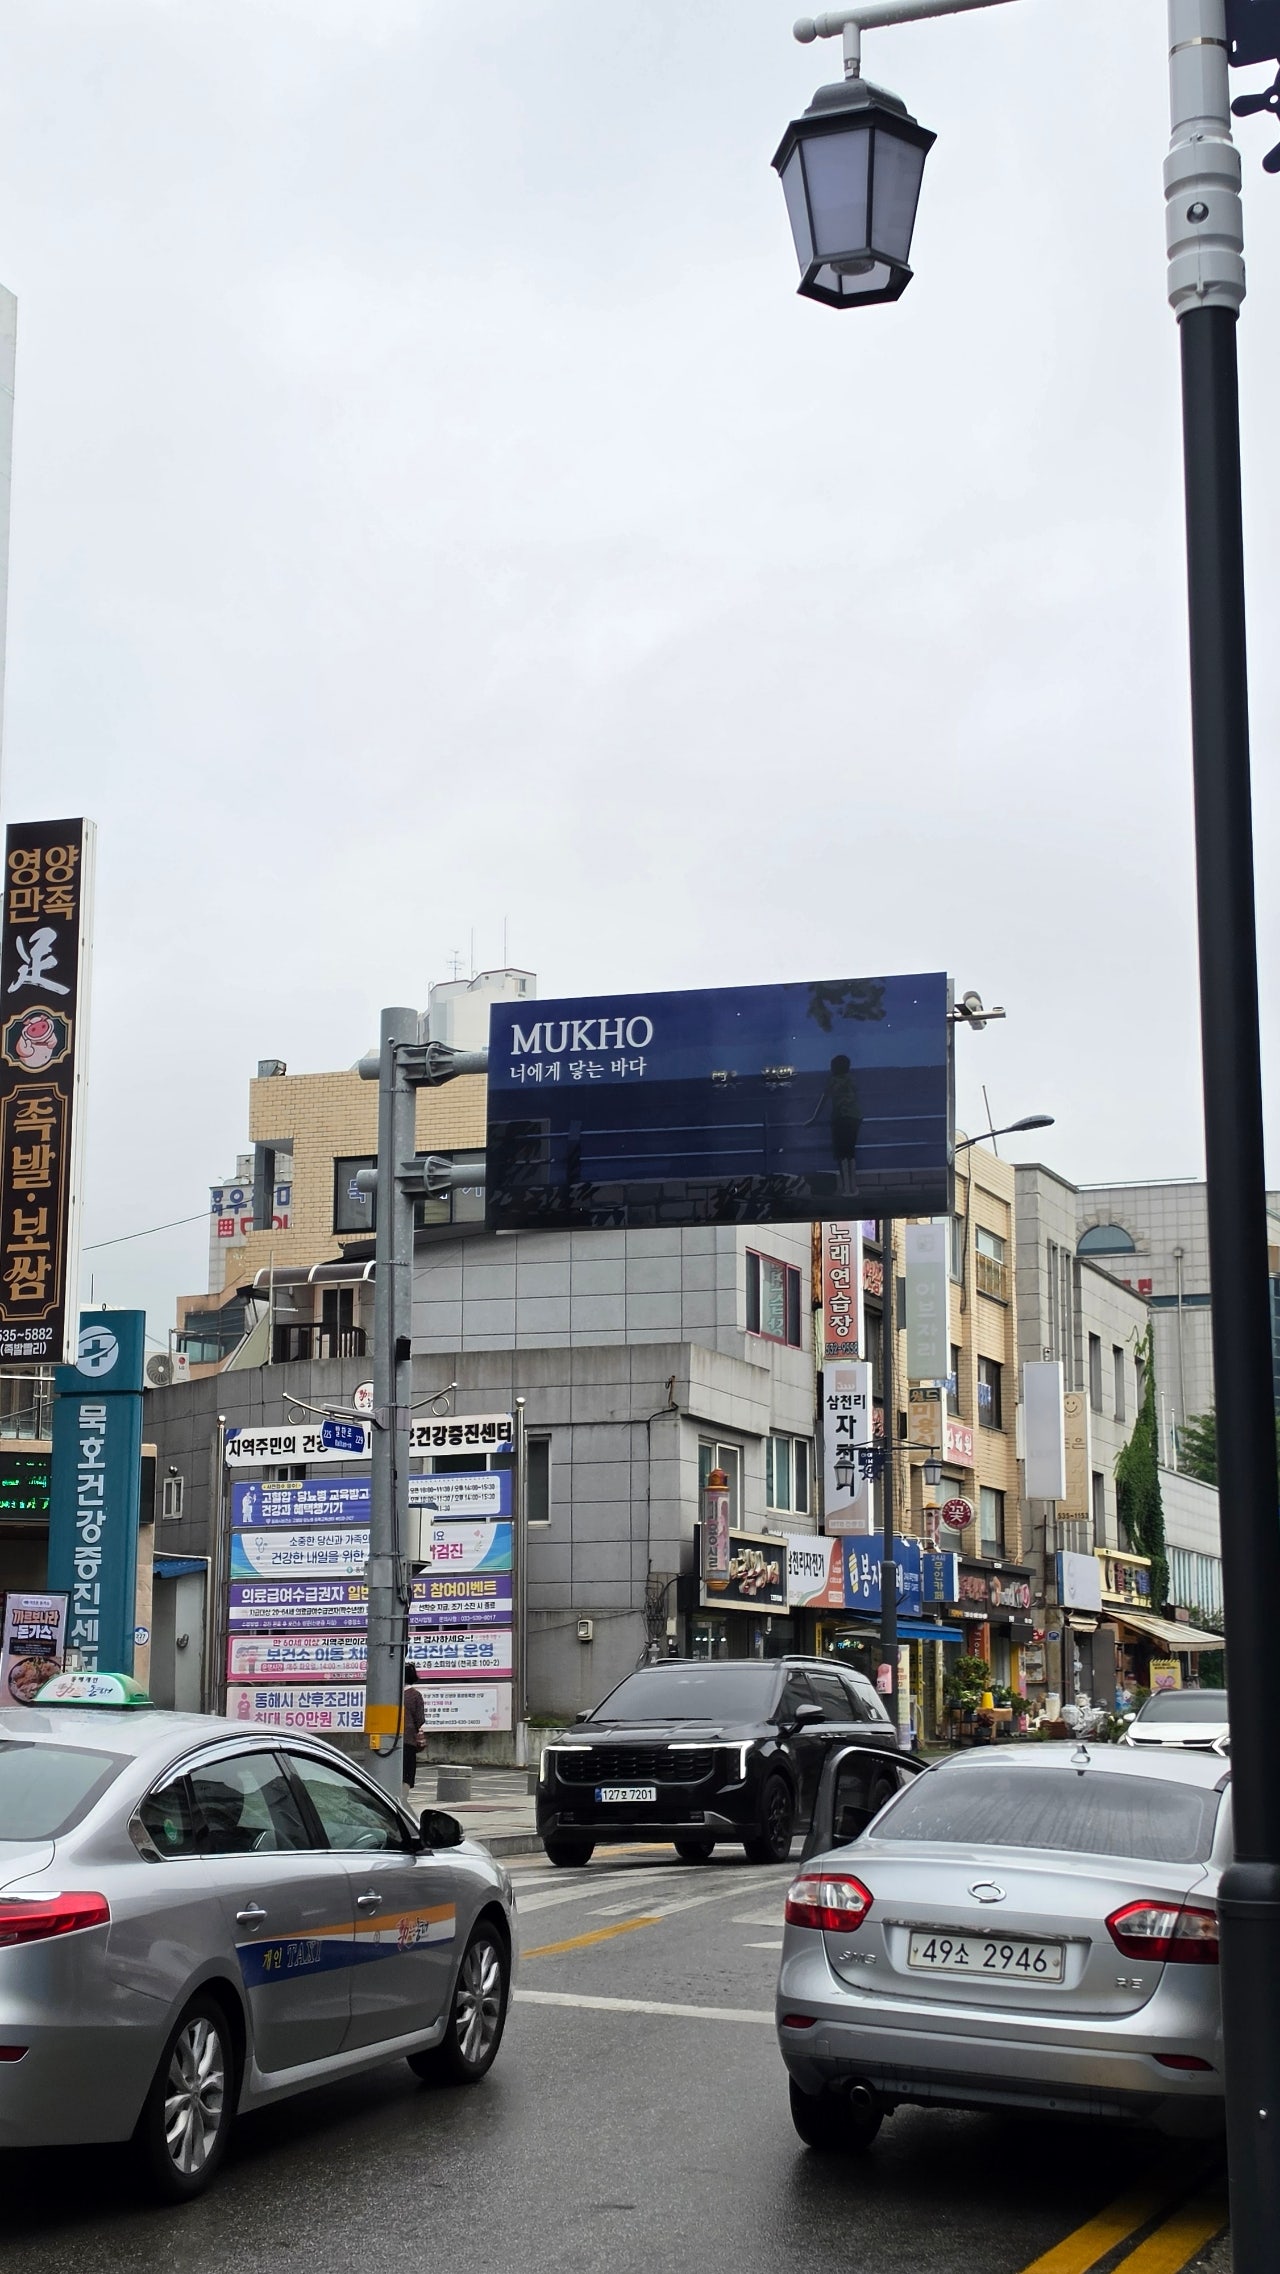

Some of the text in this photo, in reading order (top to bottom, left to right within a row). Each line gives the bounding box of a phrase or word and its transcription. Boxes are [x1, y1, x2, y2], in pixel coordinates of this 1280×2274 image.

[8, 844, 79, 885] 영양
[9, 885, 75, 923] 만족
[8, 927, 70, 996] 足
[511, 1015, 654, 1055] MUKHO
[510, 1056, 647, 1082] 너에게 닿는 바다
[828, 1223, 853, 1337] 노래연습장
[826, 1394, 866, 1410] 삼천리
[911, 1389, 939, 1401] 월드
[228, 1435, 296, 1457] 지역주민의
[329, 1488, 369, 1501] 교육받고
[262, 1502, 343, 1517] 건강과 혜택챙기기
[948, 1505, 965, 1522] 꽃
[289, 1536, 315, 1547] 소중한
[317, 1535, 342, 1546] 당신과
[272, 1549, 364, 1565] 건강한 내일을 위한
[934, 1562, 945, 1600] 무인카페
[241, 1586, 344, 1604] 의료급여수급권자
[430, 1580, 497, 1598] 참여이벤트
[464, 1602, 475, 1610] 소진
[13, 1609, 58, 1626] 까르보나라
[18, 1625, 52, 1639] 돈가스
[267, 1648, 310, 1662] 보건소
[315, 1647, 344, 1661] 이동
[409, 1644, 458, 1660] 검진실
[463, 1643, 494, 1658] 운영
[255, 1691, 363, 1708] 동해시 산후조리비
[285, 1711, 332, 1727] 50만원
[337, 1711, 363, 1727] 지원
[630, 1789, 652, 1800] 7201
[263, 1940, 321, 1970] 개인 TAXI
[922, 1938, 1048, 1973] 49소 2946
